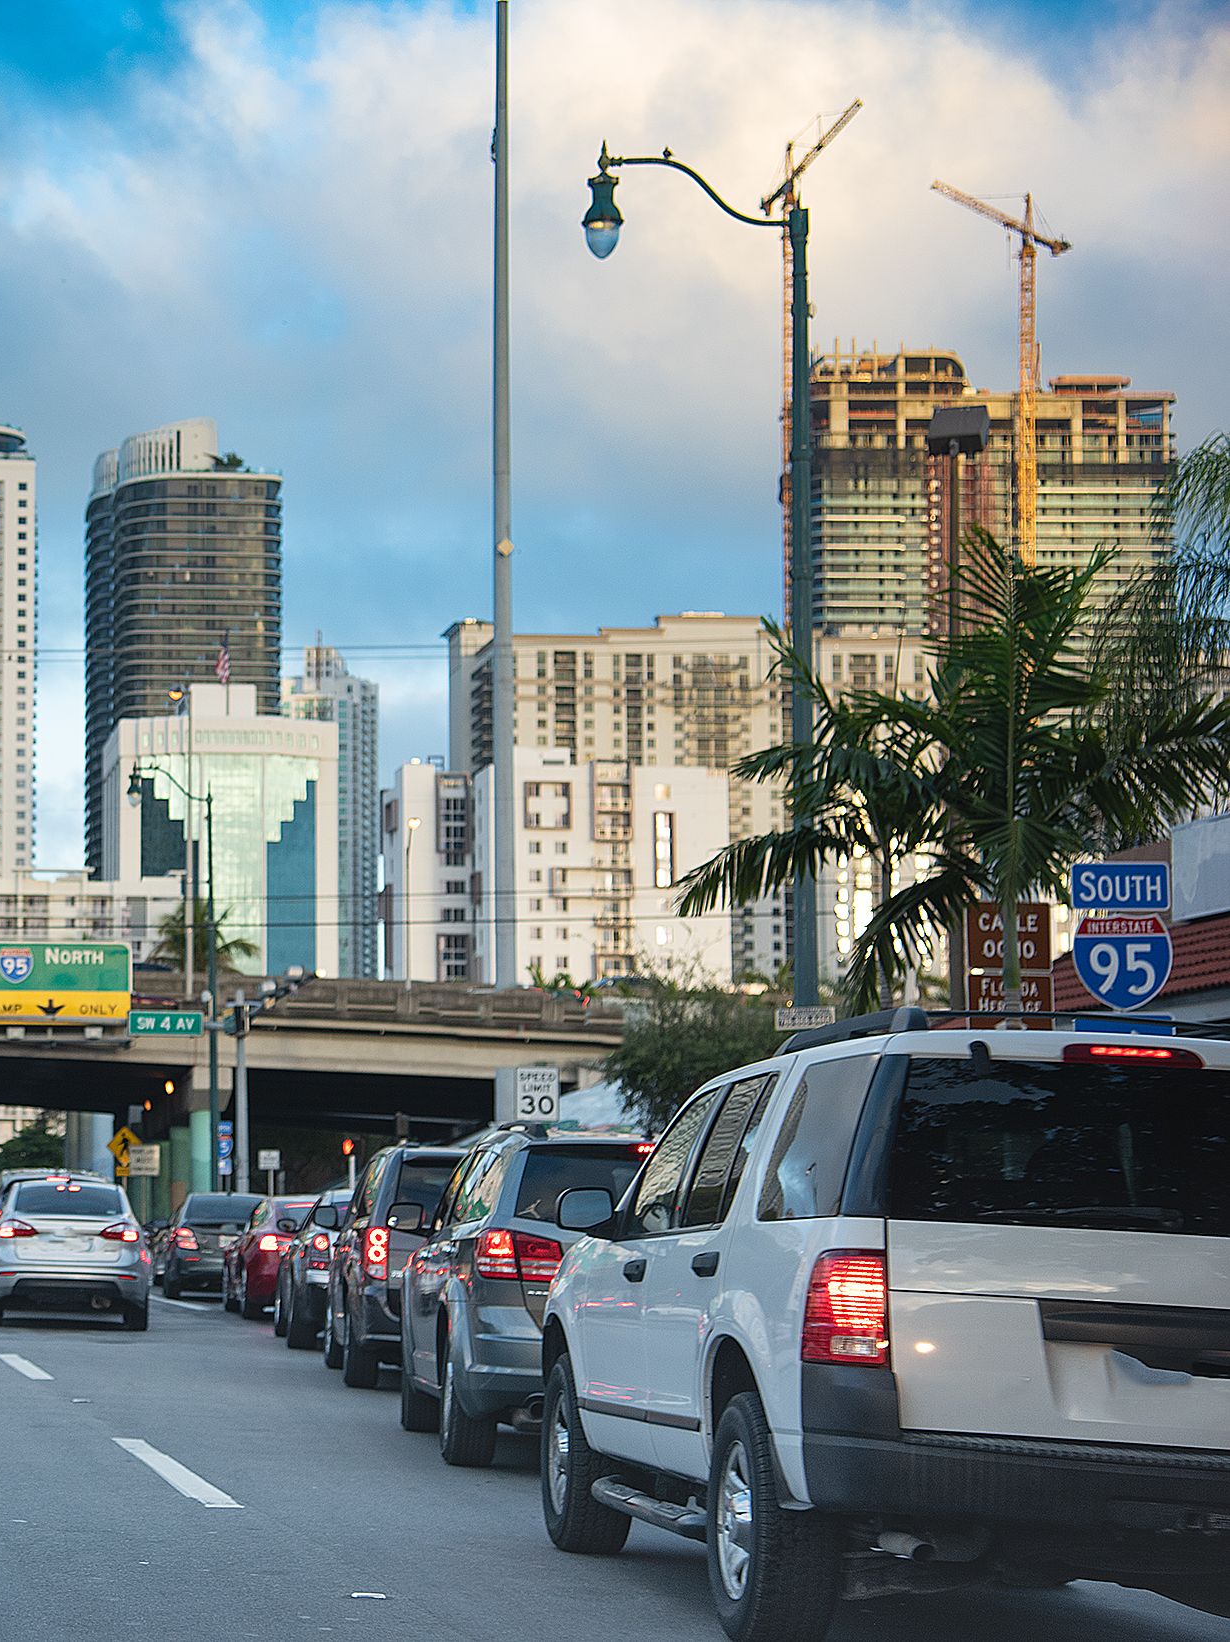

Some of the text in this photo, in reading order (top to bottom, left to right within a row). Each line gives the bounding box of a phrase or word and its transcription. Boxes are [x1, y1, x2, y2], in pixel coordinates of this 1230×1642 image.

[1079, 870, 1162, 902] SOUTH
[978, 912, 1039, 933] CALE
[1086, 920, 1154, 935] INTERSTATE
[45, 947, 104, 965] NORTH
[983, 939, 1035, 959] OCO
[1, 957, 28, 976] 95
[1089, 942, 1156, 996] 95
[79, 1004, 118, 1015] ONLY
[136, 1016, 195, 1030] SW 4 AV
[519, 1072, 556, 1082] SPEED
[523, 1083, 551, 1093] LIMIT
[520, 1095, 554, 1115] 30
